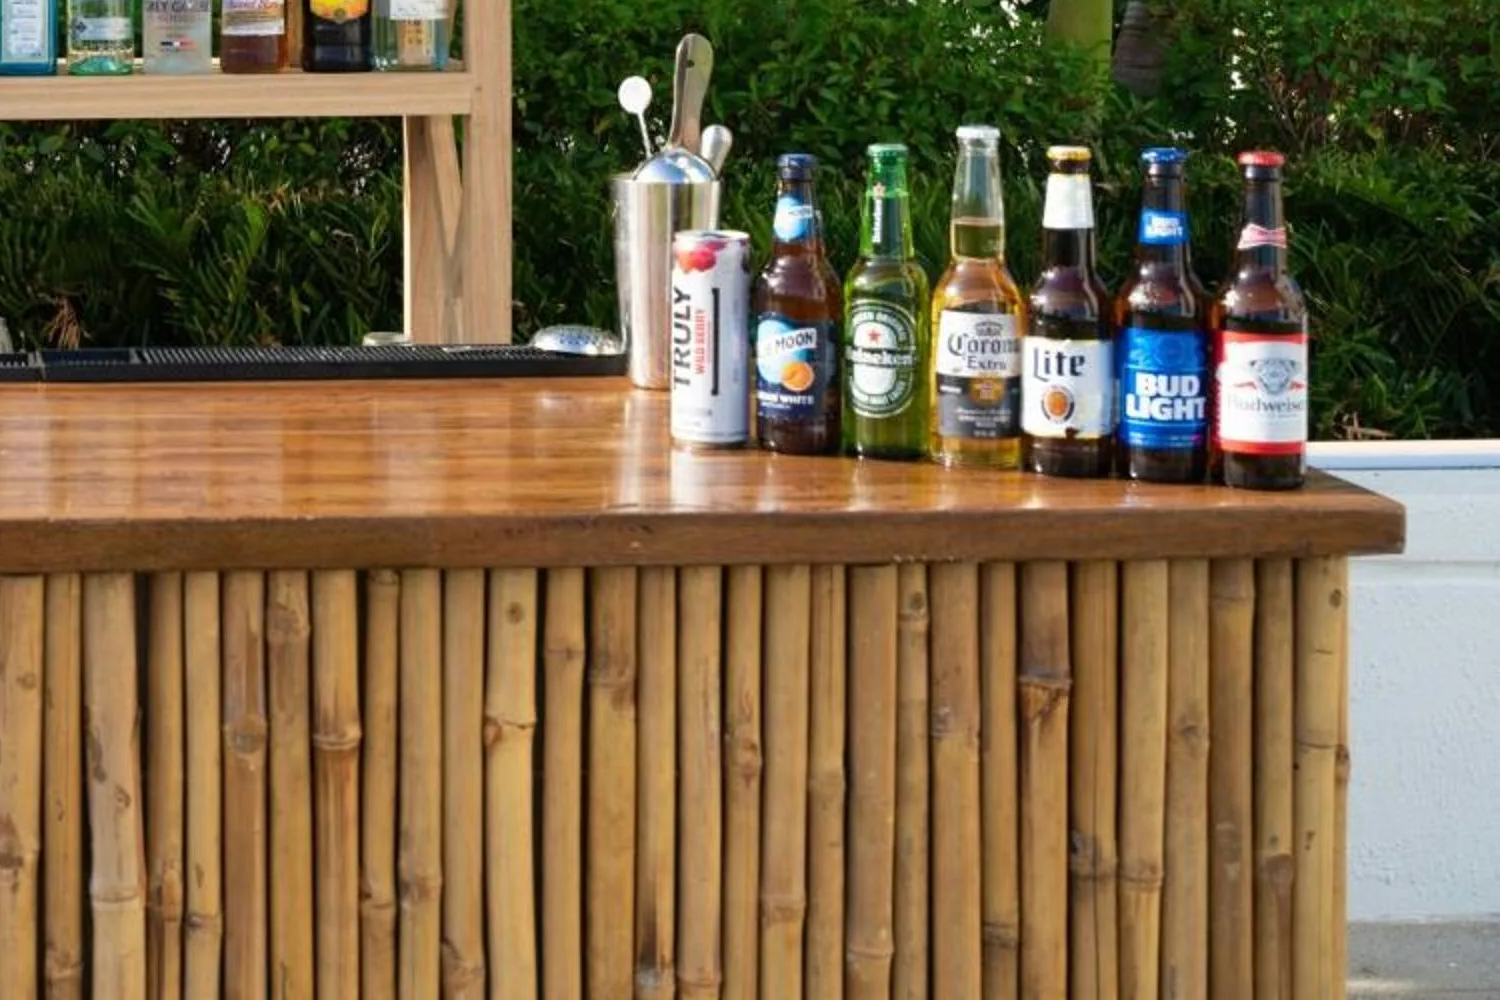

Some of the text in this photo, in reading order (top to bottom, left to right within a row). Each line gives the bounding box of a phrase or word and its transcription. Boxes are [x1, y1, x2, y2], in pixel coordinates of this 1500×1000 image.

[673, 286, 692, 390] TRULY
[775, 331, 814, 350] MOON
[966, 355, 1008, 371] Extra
[1033, 347, 1086, 382] Lite
[1135, 371, 1201, 398] BUD
[1125, 394, 1207, 421] LIGHT
